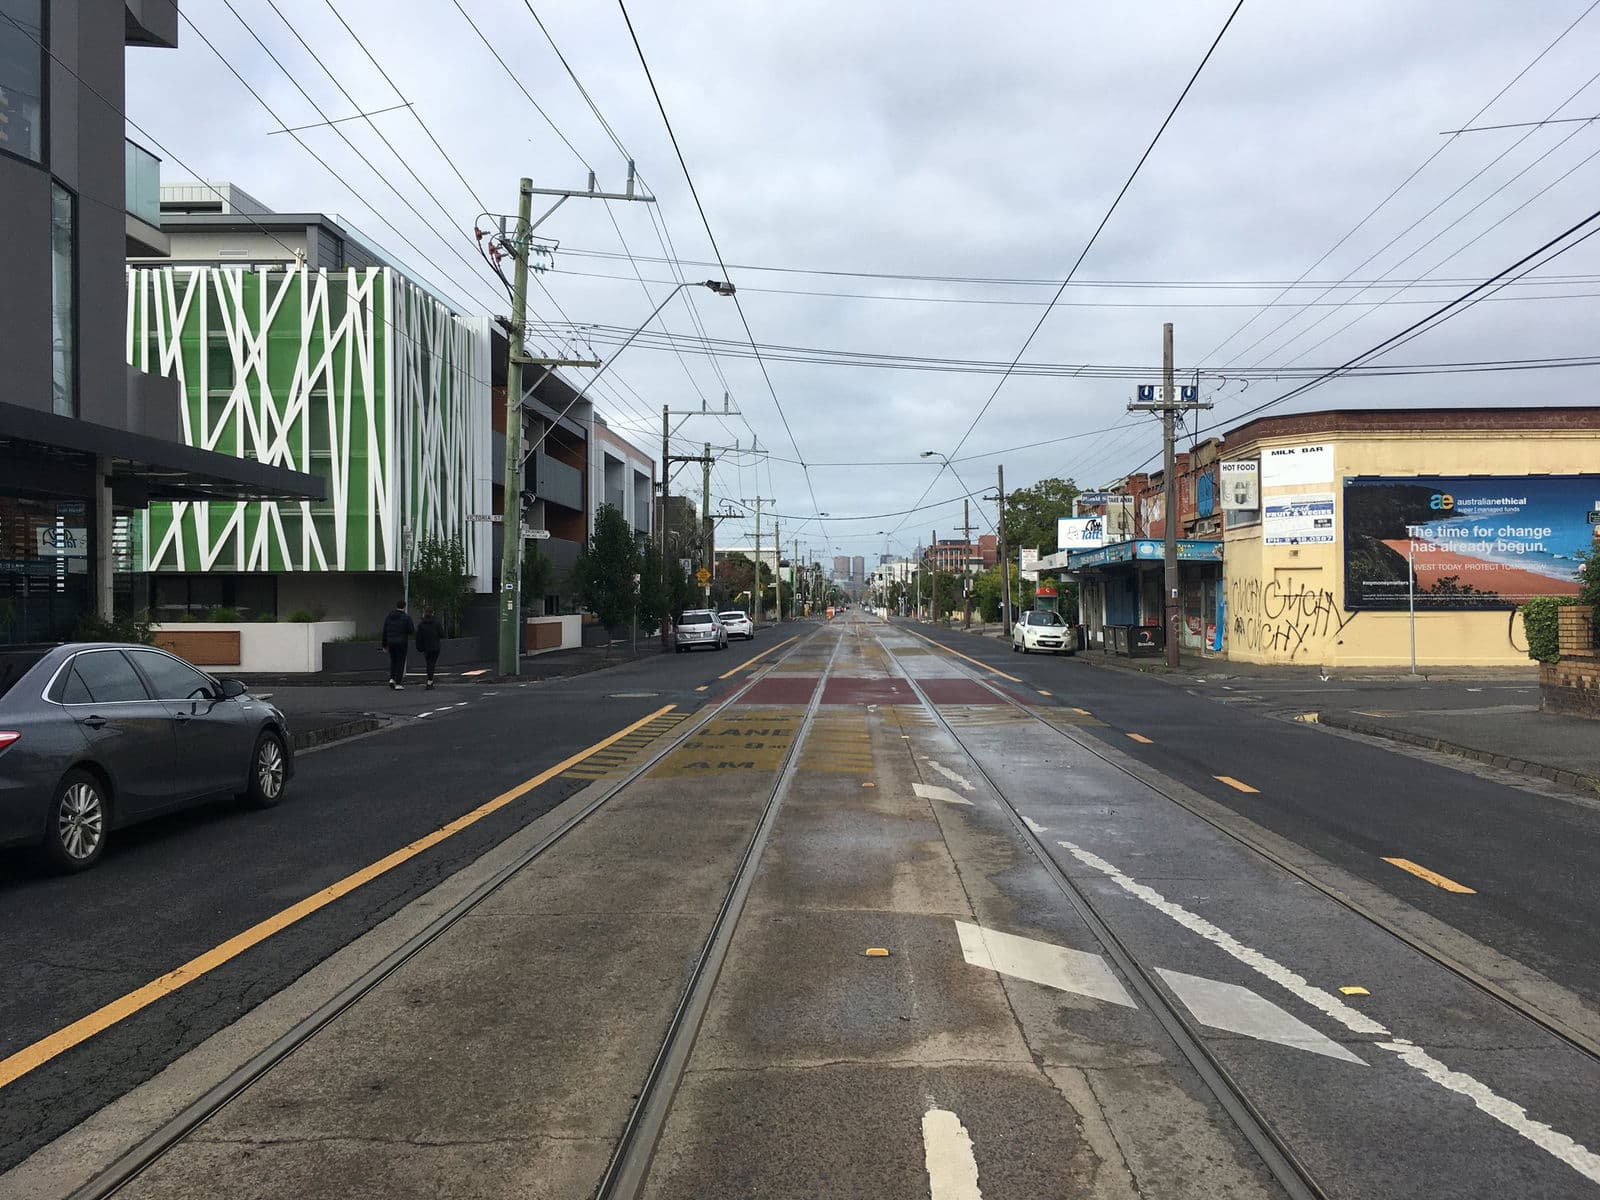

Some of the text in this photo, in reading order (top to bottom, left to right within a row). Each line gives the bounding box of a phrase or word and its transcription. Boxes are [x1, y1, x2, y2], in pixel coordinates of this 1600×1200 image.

[1457, 497, 1527, 506] australianethical
[1406, 525, 1552, 539] The time for change
[1410, 540, 1547, 554] has already begun.
[1464, 563, 1499, 571] PROTECT
[682, 761, 755, 769] AM
